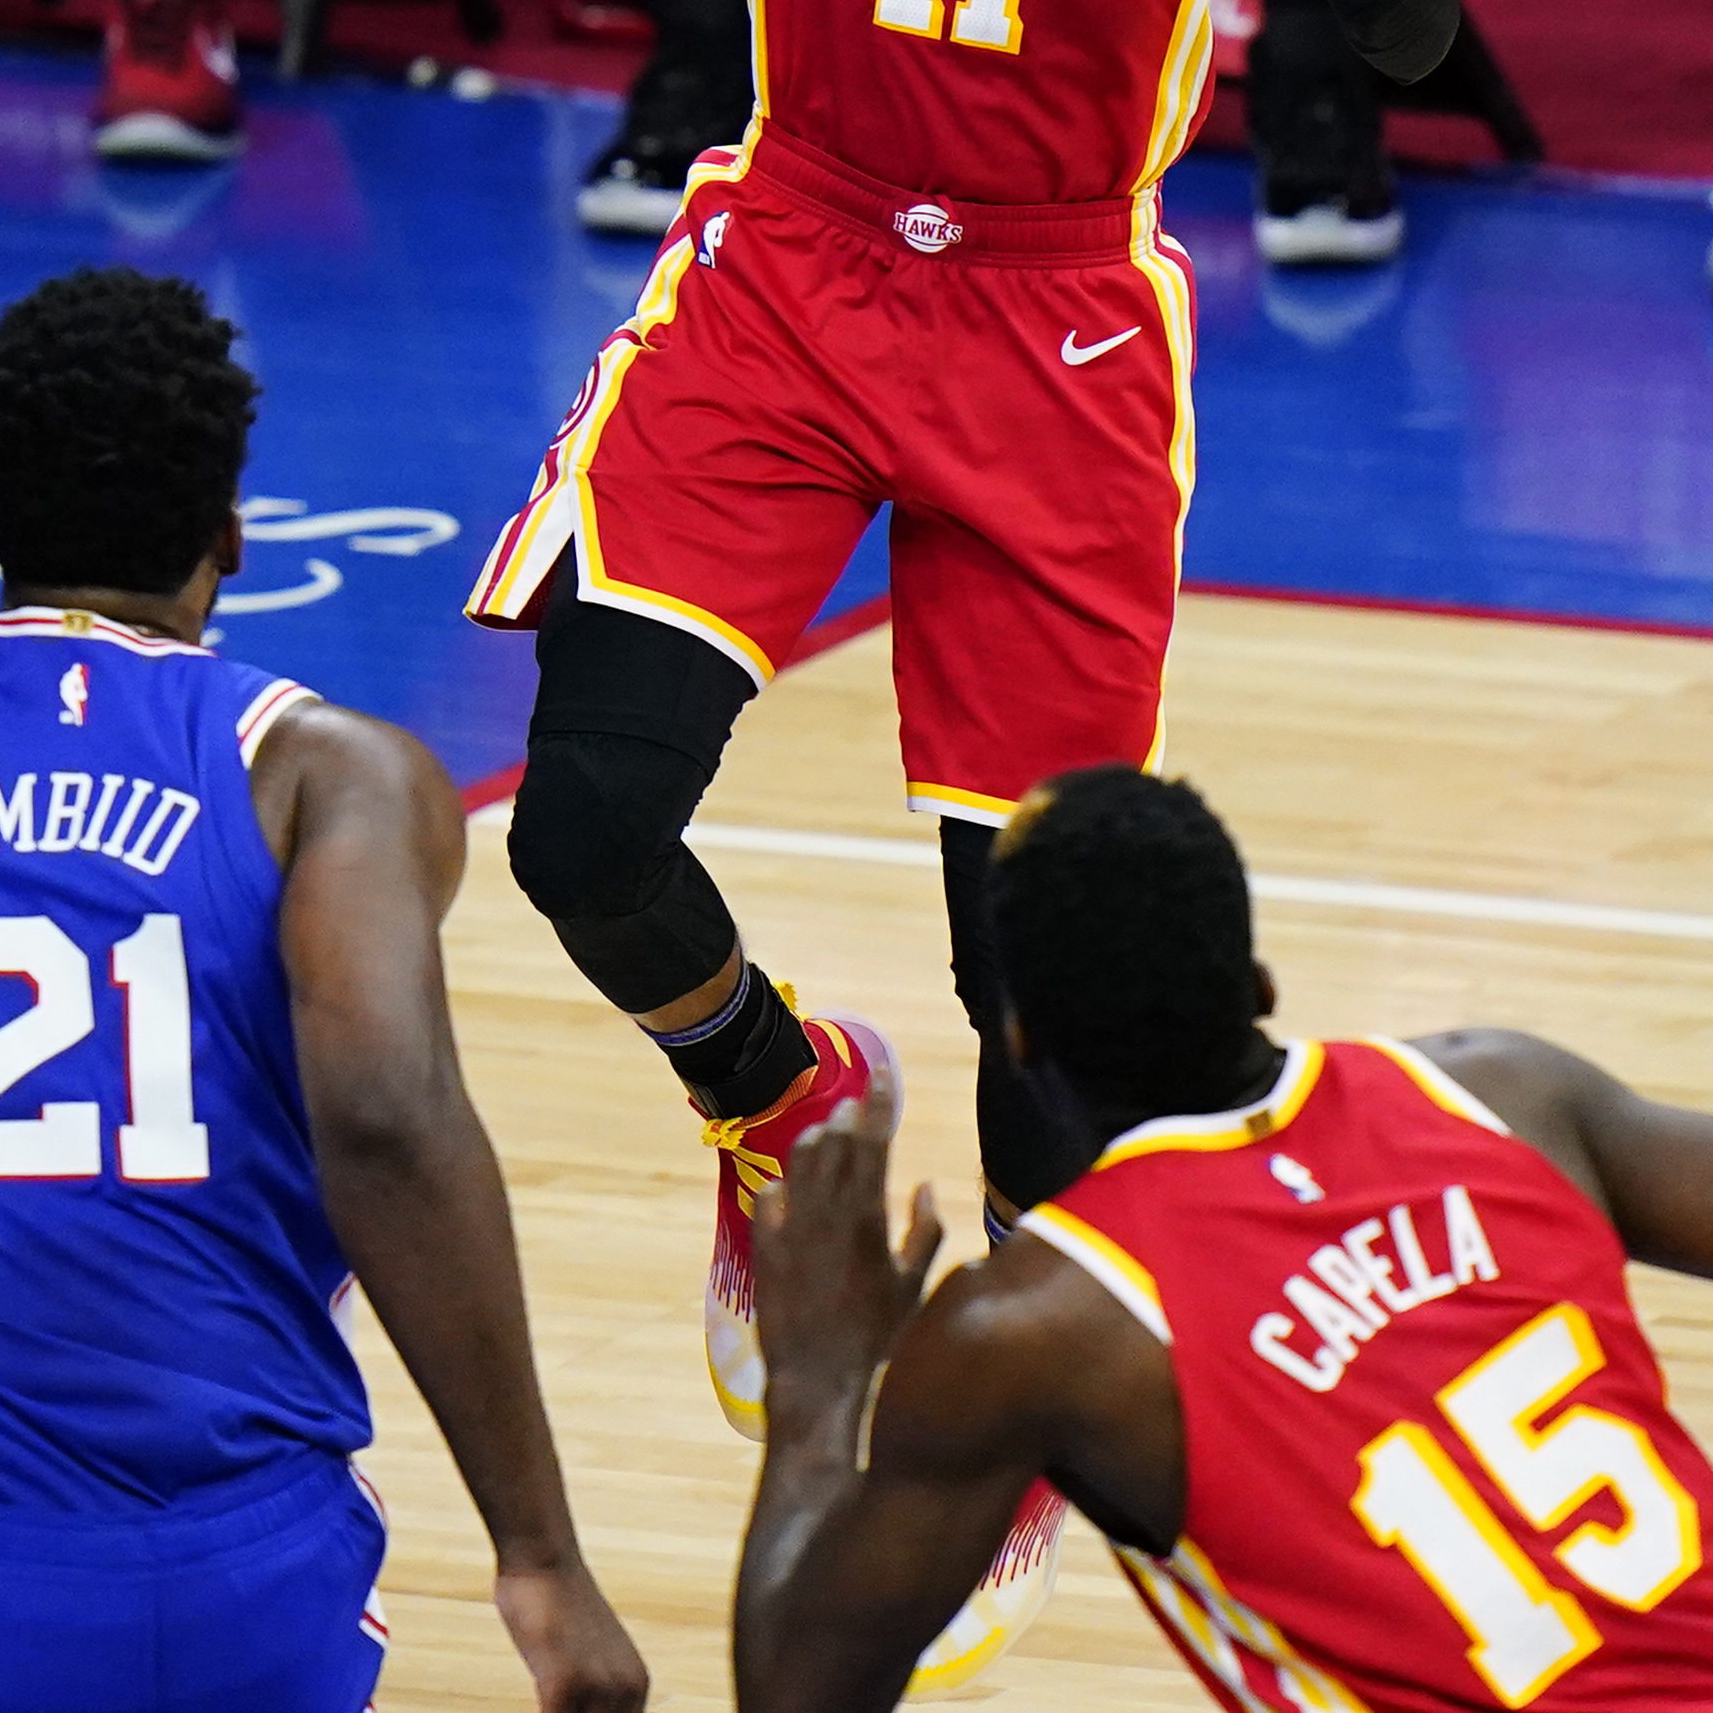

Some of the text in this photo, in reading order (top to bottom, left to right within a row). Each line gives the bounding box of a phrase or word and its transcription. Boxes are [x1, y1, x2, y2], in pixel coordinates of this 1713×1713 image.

[893, 212, 963, 243] HAWKS
[1250, 1184, 1500, 1393] CAPELA
[1349, 1300, 1704, 1710] 15
